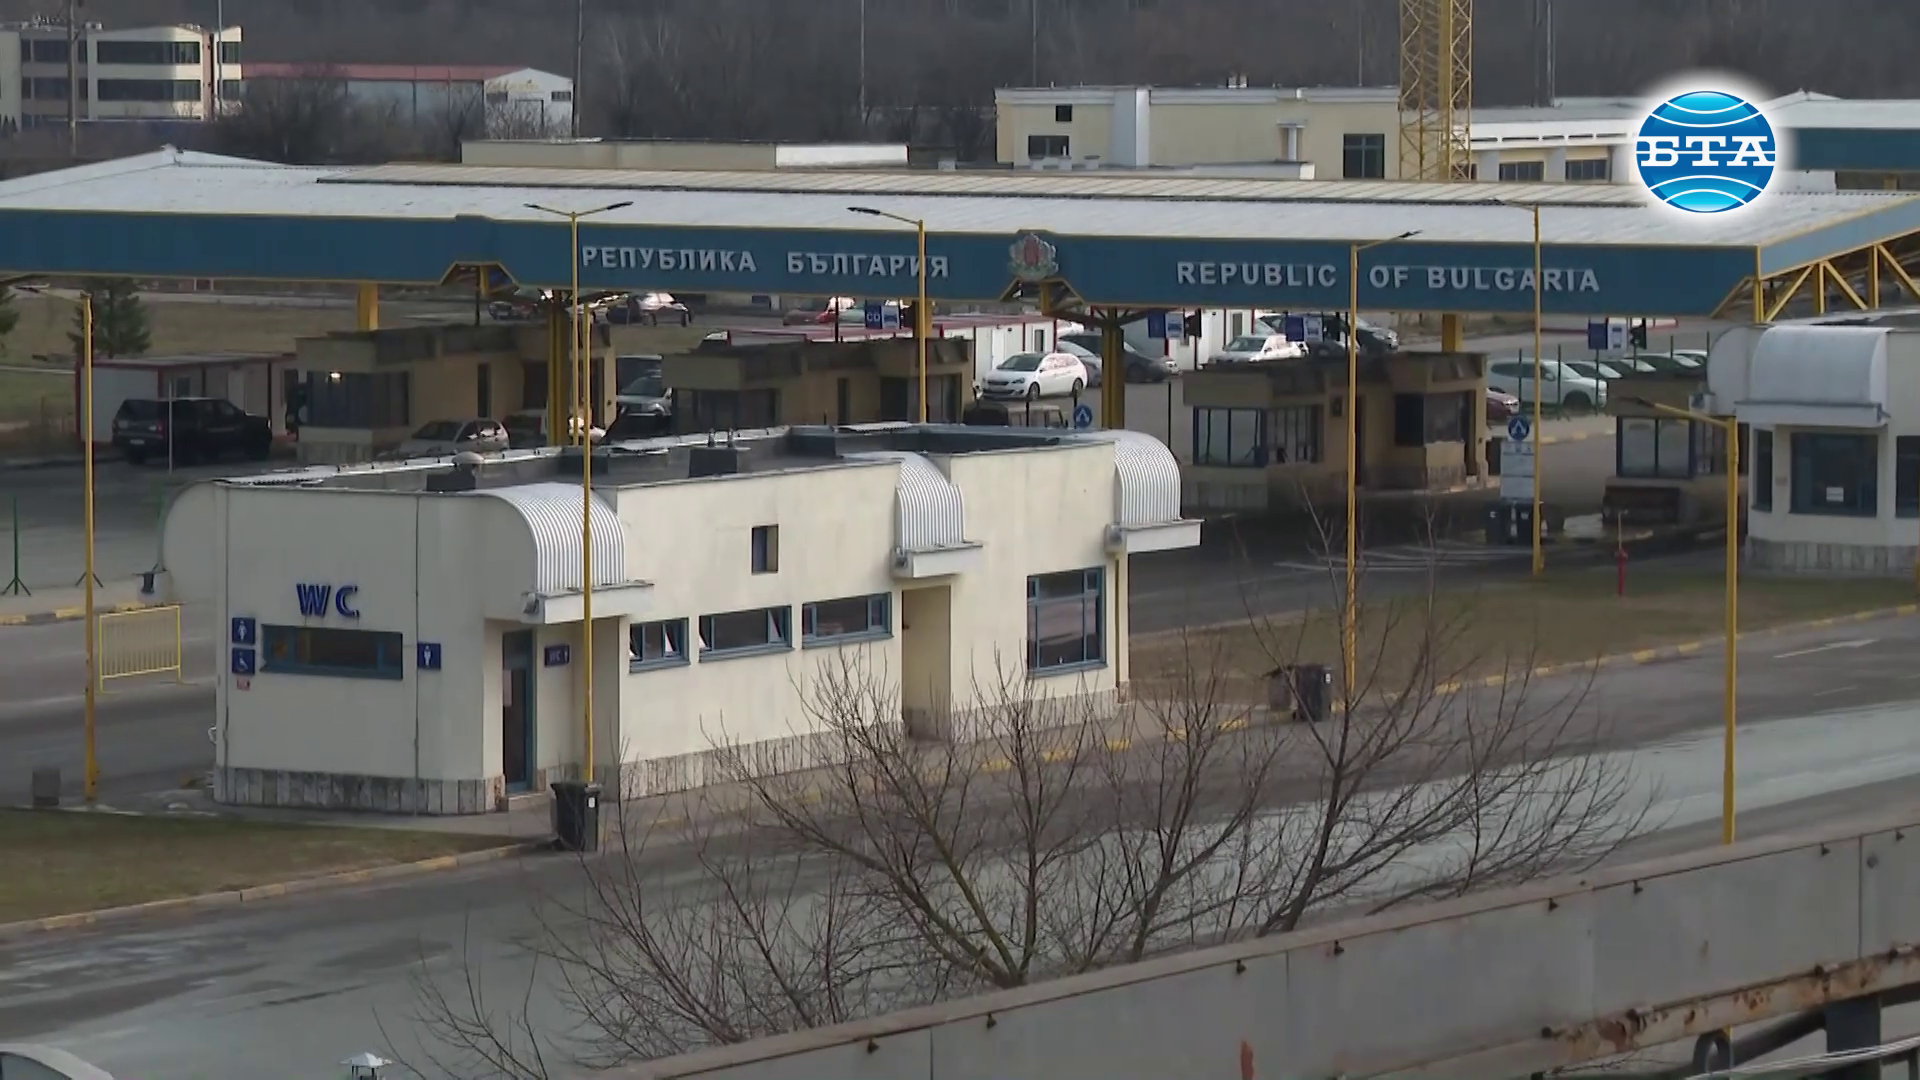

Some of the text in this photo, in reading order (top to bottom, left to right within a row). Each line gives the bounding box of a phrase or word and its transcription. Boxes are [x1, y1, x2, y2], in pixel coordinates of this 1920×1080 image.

[582, 246, 757, 272] РЕПУБЛИКА
[1177, 262, 1600, 292] REPUBLIC OF BULGARIA
[296, 583, 360, 618] WC
